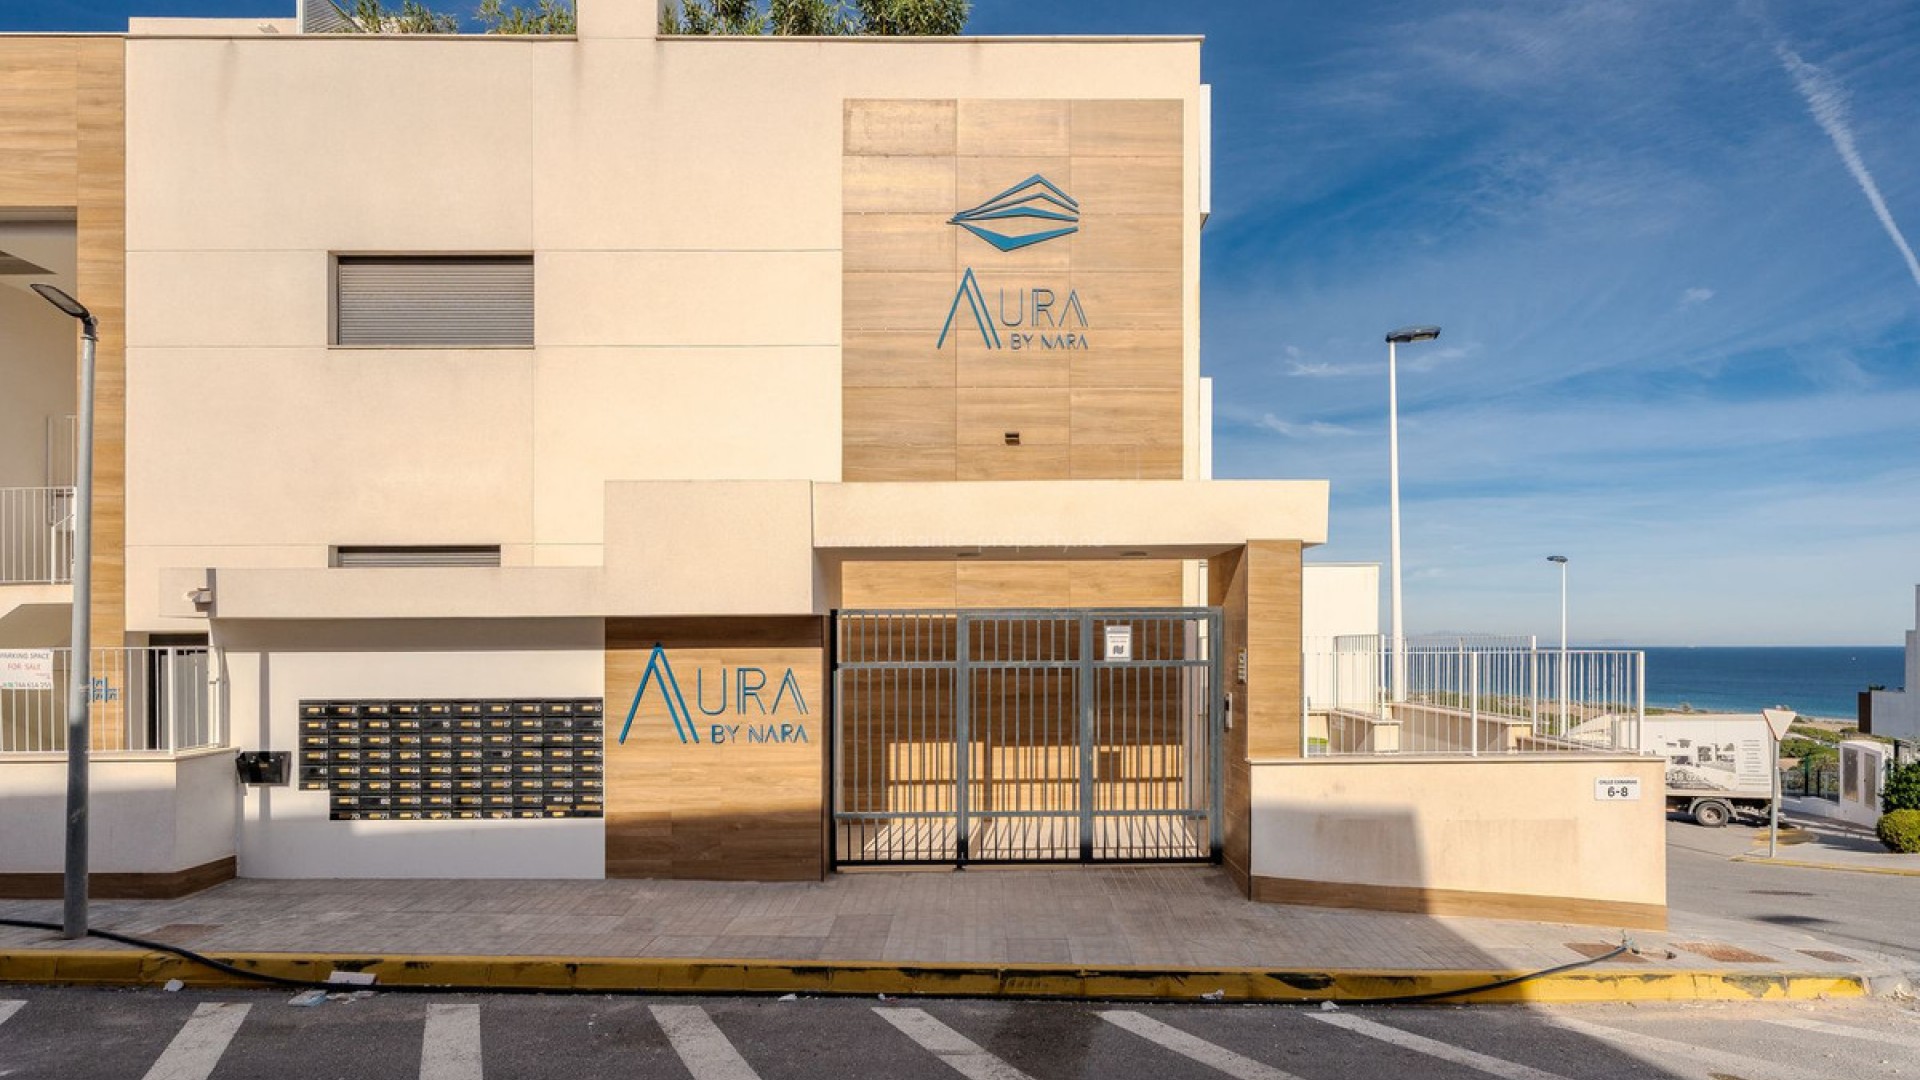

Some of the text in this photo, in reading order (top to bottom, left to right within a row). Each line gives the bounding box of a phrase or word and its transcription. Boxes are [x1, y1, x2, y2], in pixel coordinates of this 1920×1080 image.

[936, 267, 1089, 349] AURA
[1010, 333, 1089, 350] BY NARA
[618, 642, 809, 745] AURA
[711, 724, 809, 744] BY NARA
[1607, 786, 1629, 797] 6-8
